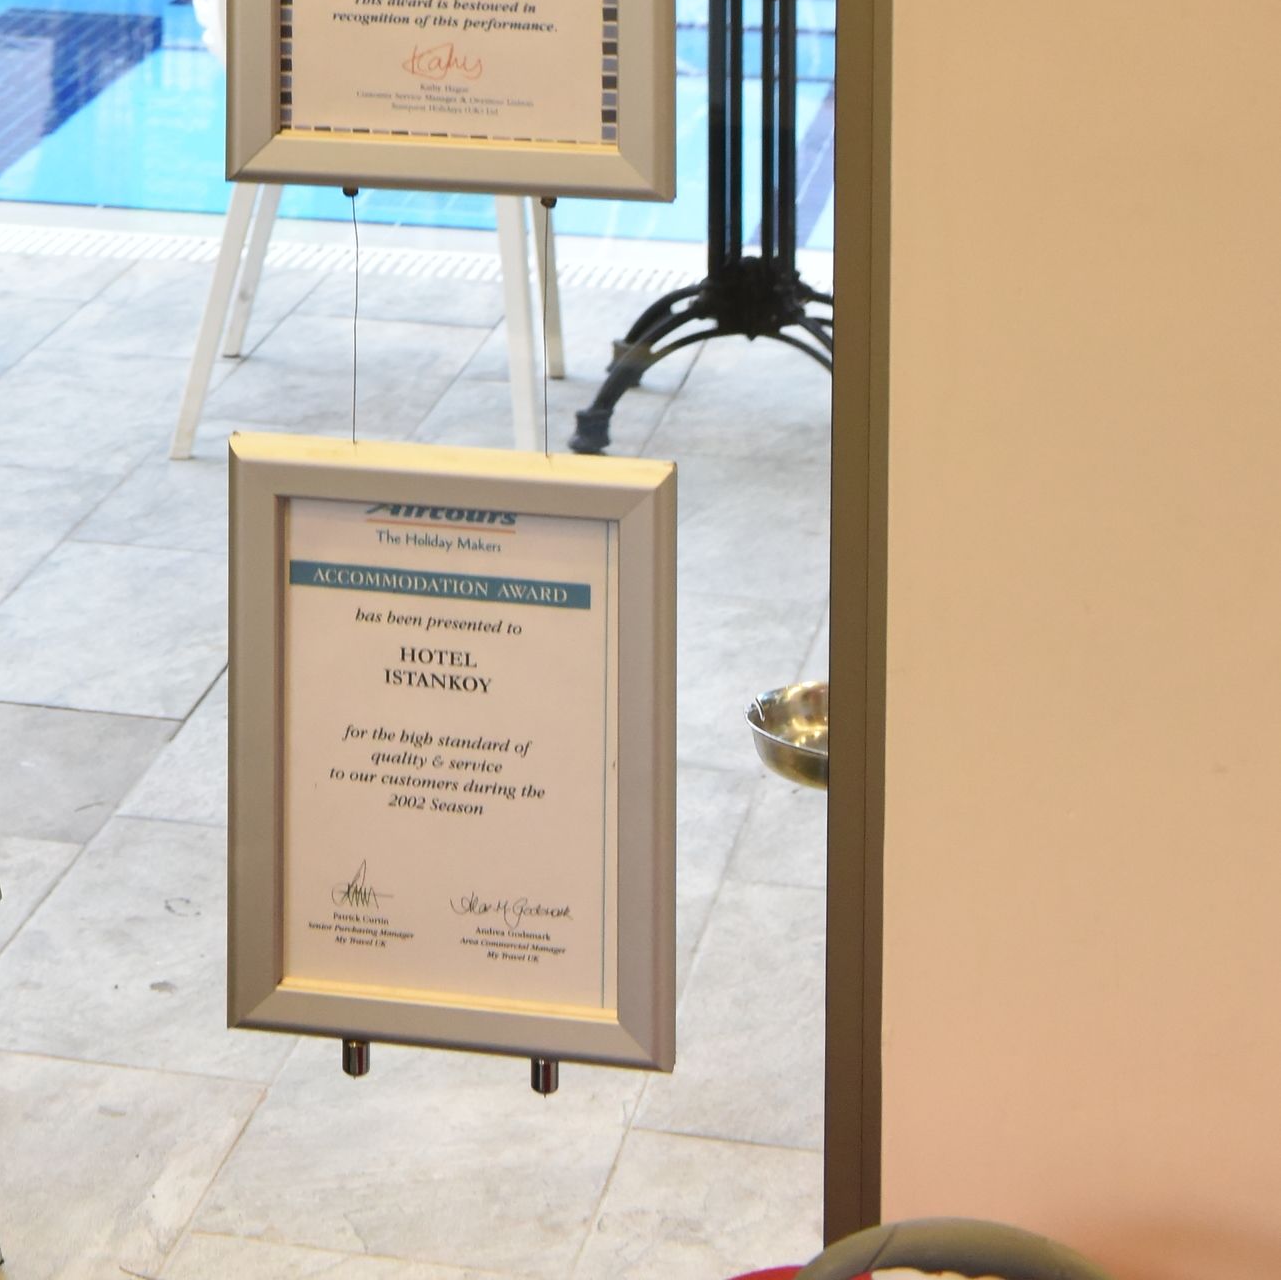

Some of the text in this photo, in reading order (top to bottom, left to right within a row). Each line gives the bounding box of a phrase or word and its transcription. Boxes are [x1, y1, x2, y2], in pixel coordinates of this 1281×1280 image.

[453, 0, 518, 13] bestowed
[523, 2, 536, 13] in
[333, 11, 557, 32] recognition of this performance.
[376, 529, 501, 553] The Holiday Makers
[313, 566, 568, 603] ACCOMMODATION AWARD
[355, 607, 522, 635] has been presented to
[400, 646, 478, 669] HOTEL
[384, 669, 492, 693] ISTANKOY
[342, 725, 533, 758] for the high standard of
[371, 751, 503, 774] quality & service
[329, 767, 545, 800] to our customers during the
[388, 793, 484, 816] 2002 Season
